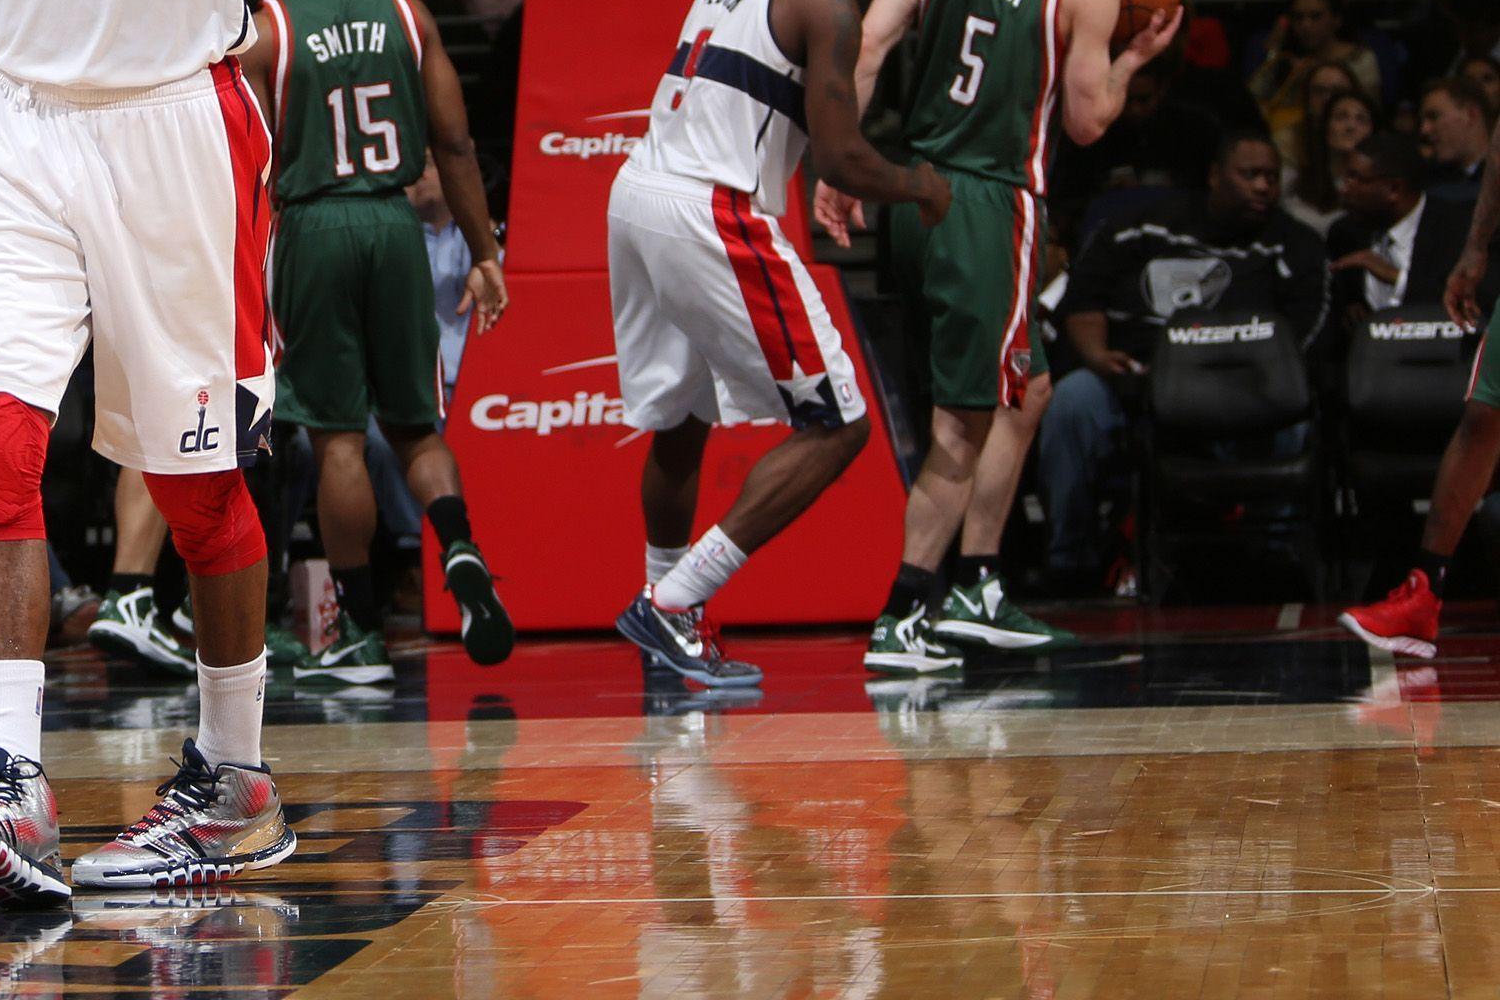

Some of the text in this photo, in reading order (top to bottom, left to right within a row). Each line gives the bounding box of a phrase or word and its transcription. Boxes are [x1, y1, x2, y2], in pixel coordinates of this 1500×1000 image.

[306, 20, 387, 64] SMITH
[948, 13, 998, 107] 5
[326, 81, 402, 178] 15
[539, 131, 642, 159] Capita
[1167, 315, 1276, 345] wizards
[179, 404, 220, 454] dc
[469, 391, 625, 435] Capita
